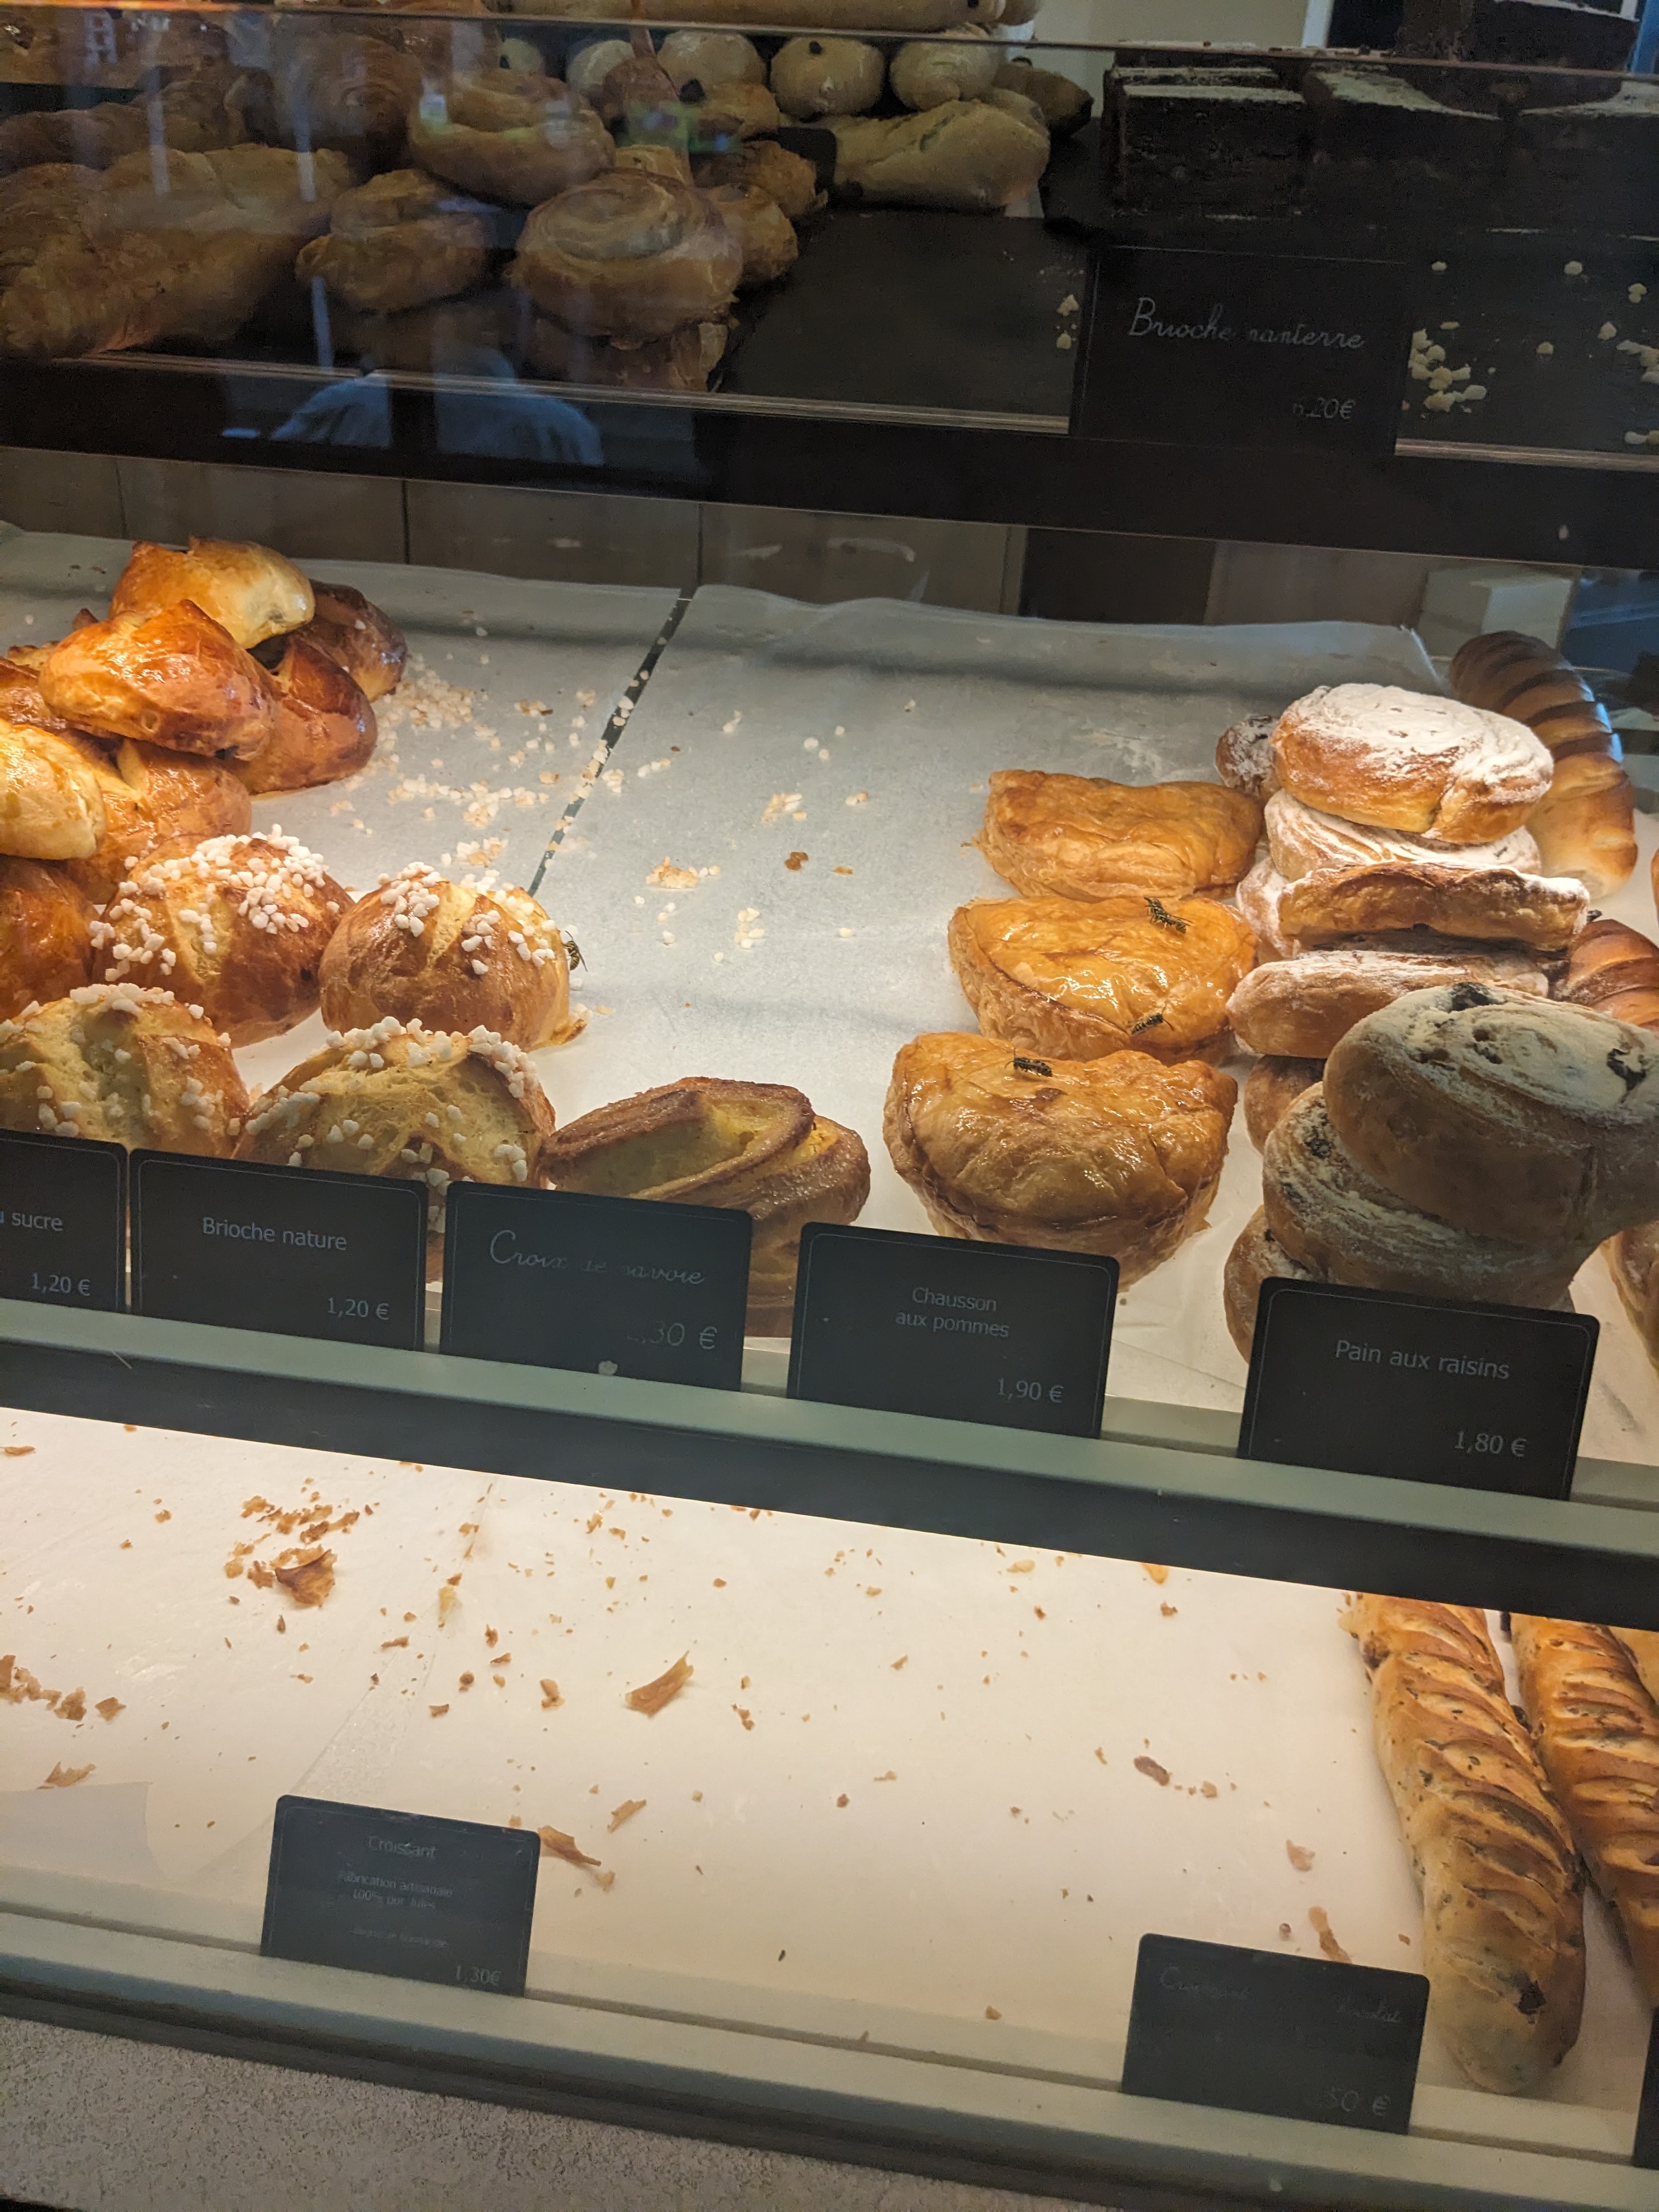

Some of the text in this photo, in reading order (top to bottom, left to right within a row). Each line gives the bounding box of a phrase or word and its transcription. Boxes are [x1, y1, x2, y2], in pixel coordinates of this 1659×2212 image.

[1128, 296, 1236, 341] Brioche
[11, 1212, 64, 1232] sucre
[202, 1217, 348, 1251] Brioche nature
[489, 1228, 569, 1270] Croix
[32, 1272, 91, 1297] 1,20 €
[328, 1297, 390, 1321] 1,20 €
[912, 1286, 997, 1312] Chausson
[698, 1325, 718, 1350] €
[895, 1312, 1009, 1338] aux pommes
[1335, 1340, 1510, 1380] Pain aux raisins
[997, 1378, 1064, 1403] 1,90 €
[1454, 1430, 1528, 1458] 1,80 €
